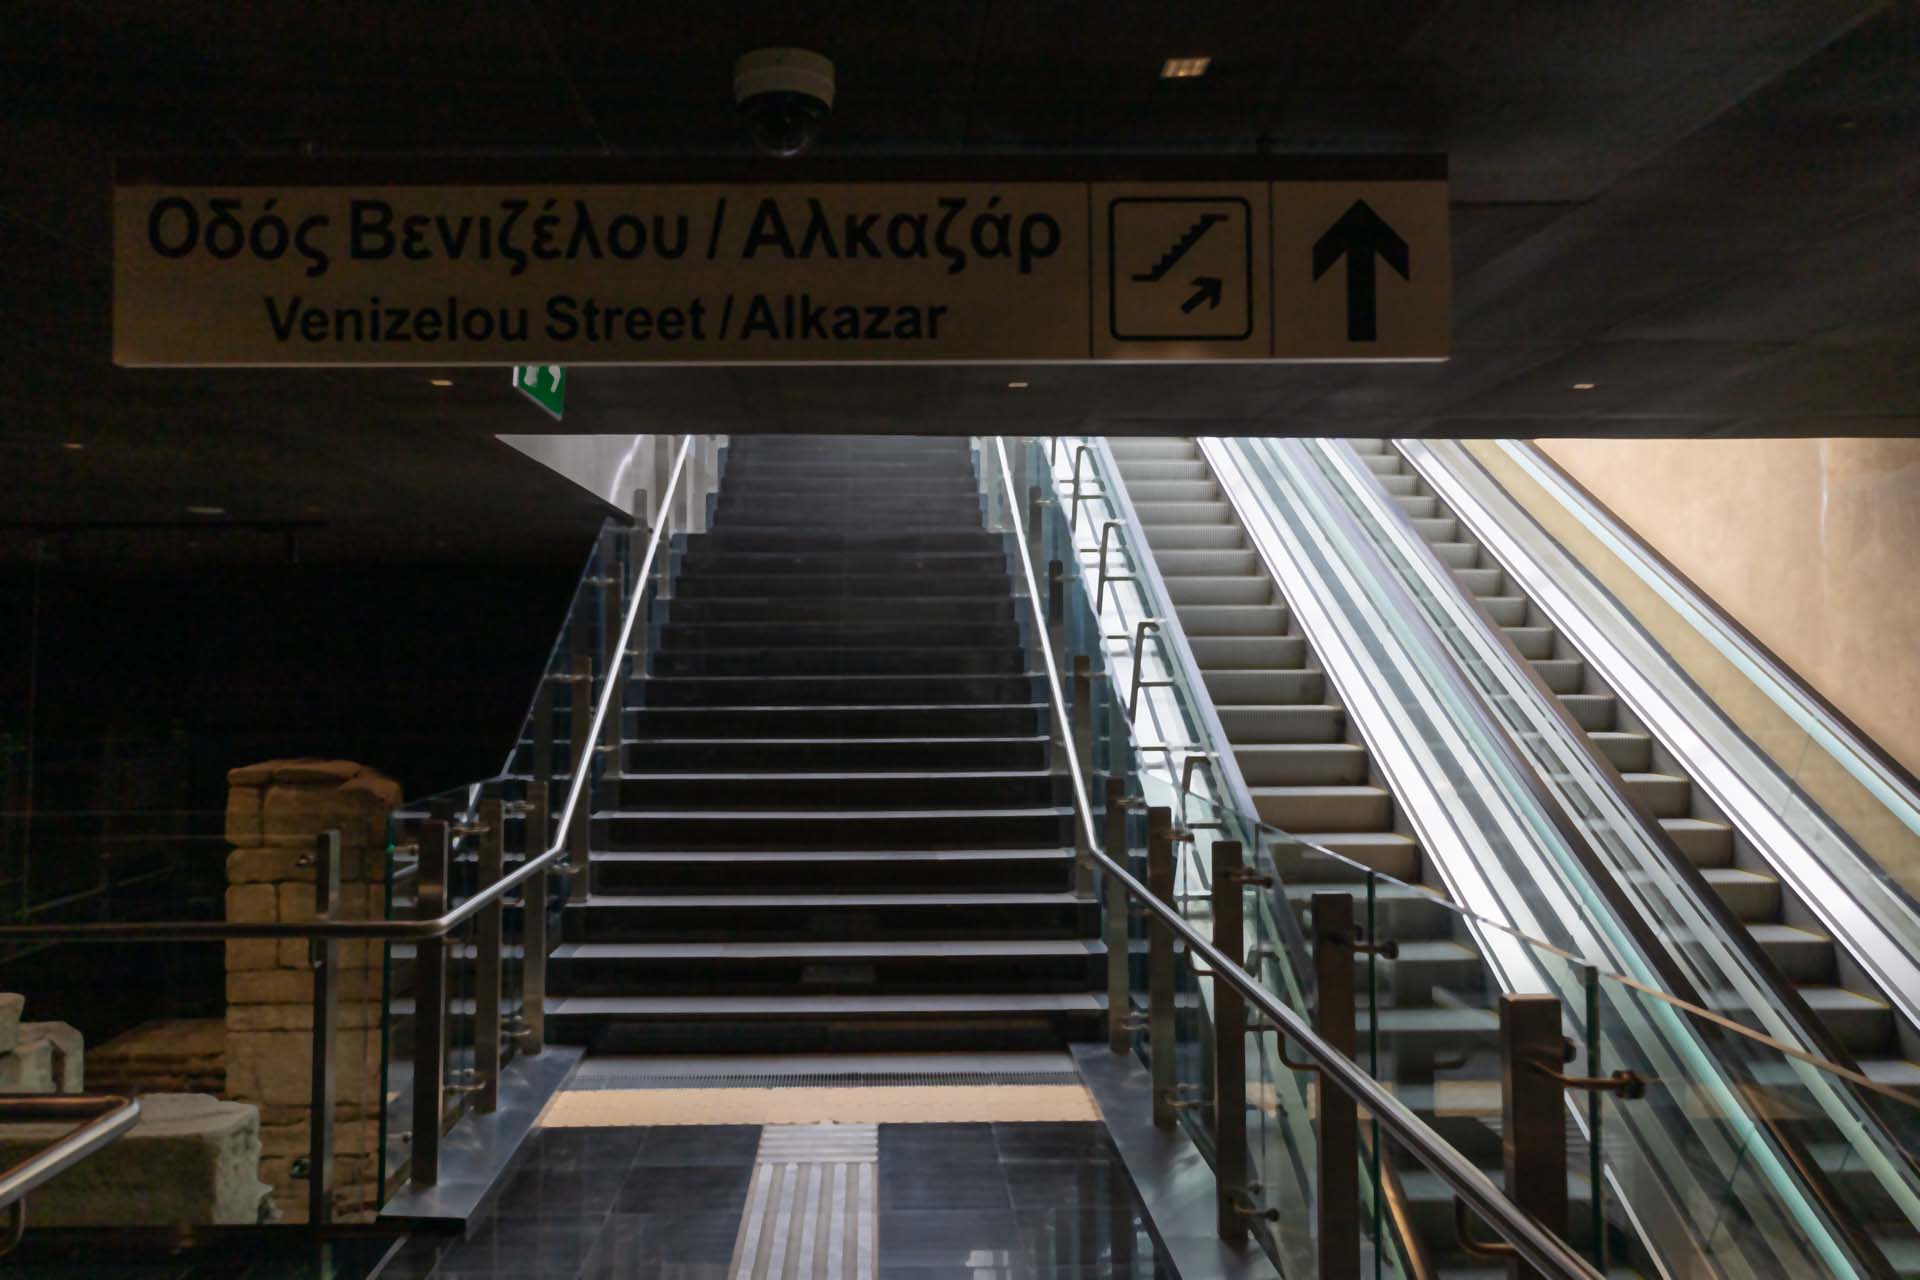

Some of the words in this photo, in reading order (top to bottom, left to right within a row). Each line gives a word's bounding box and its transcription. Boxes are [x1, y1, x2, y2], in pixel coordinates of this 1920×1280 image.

[147, 195, 331, 278] Οδός
[349, 197, 689, 277] Βενιζέλου
[740, 195, 1062, 275] Αλκαζάρ
[263, 295, 529, 343] Venizelou
[545, 295, 706, 343] Street
[739, 293, 948, 341] Alkazar
